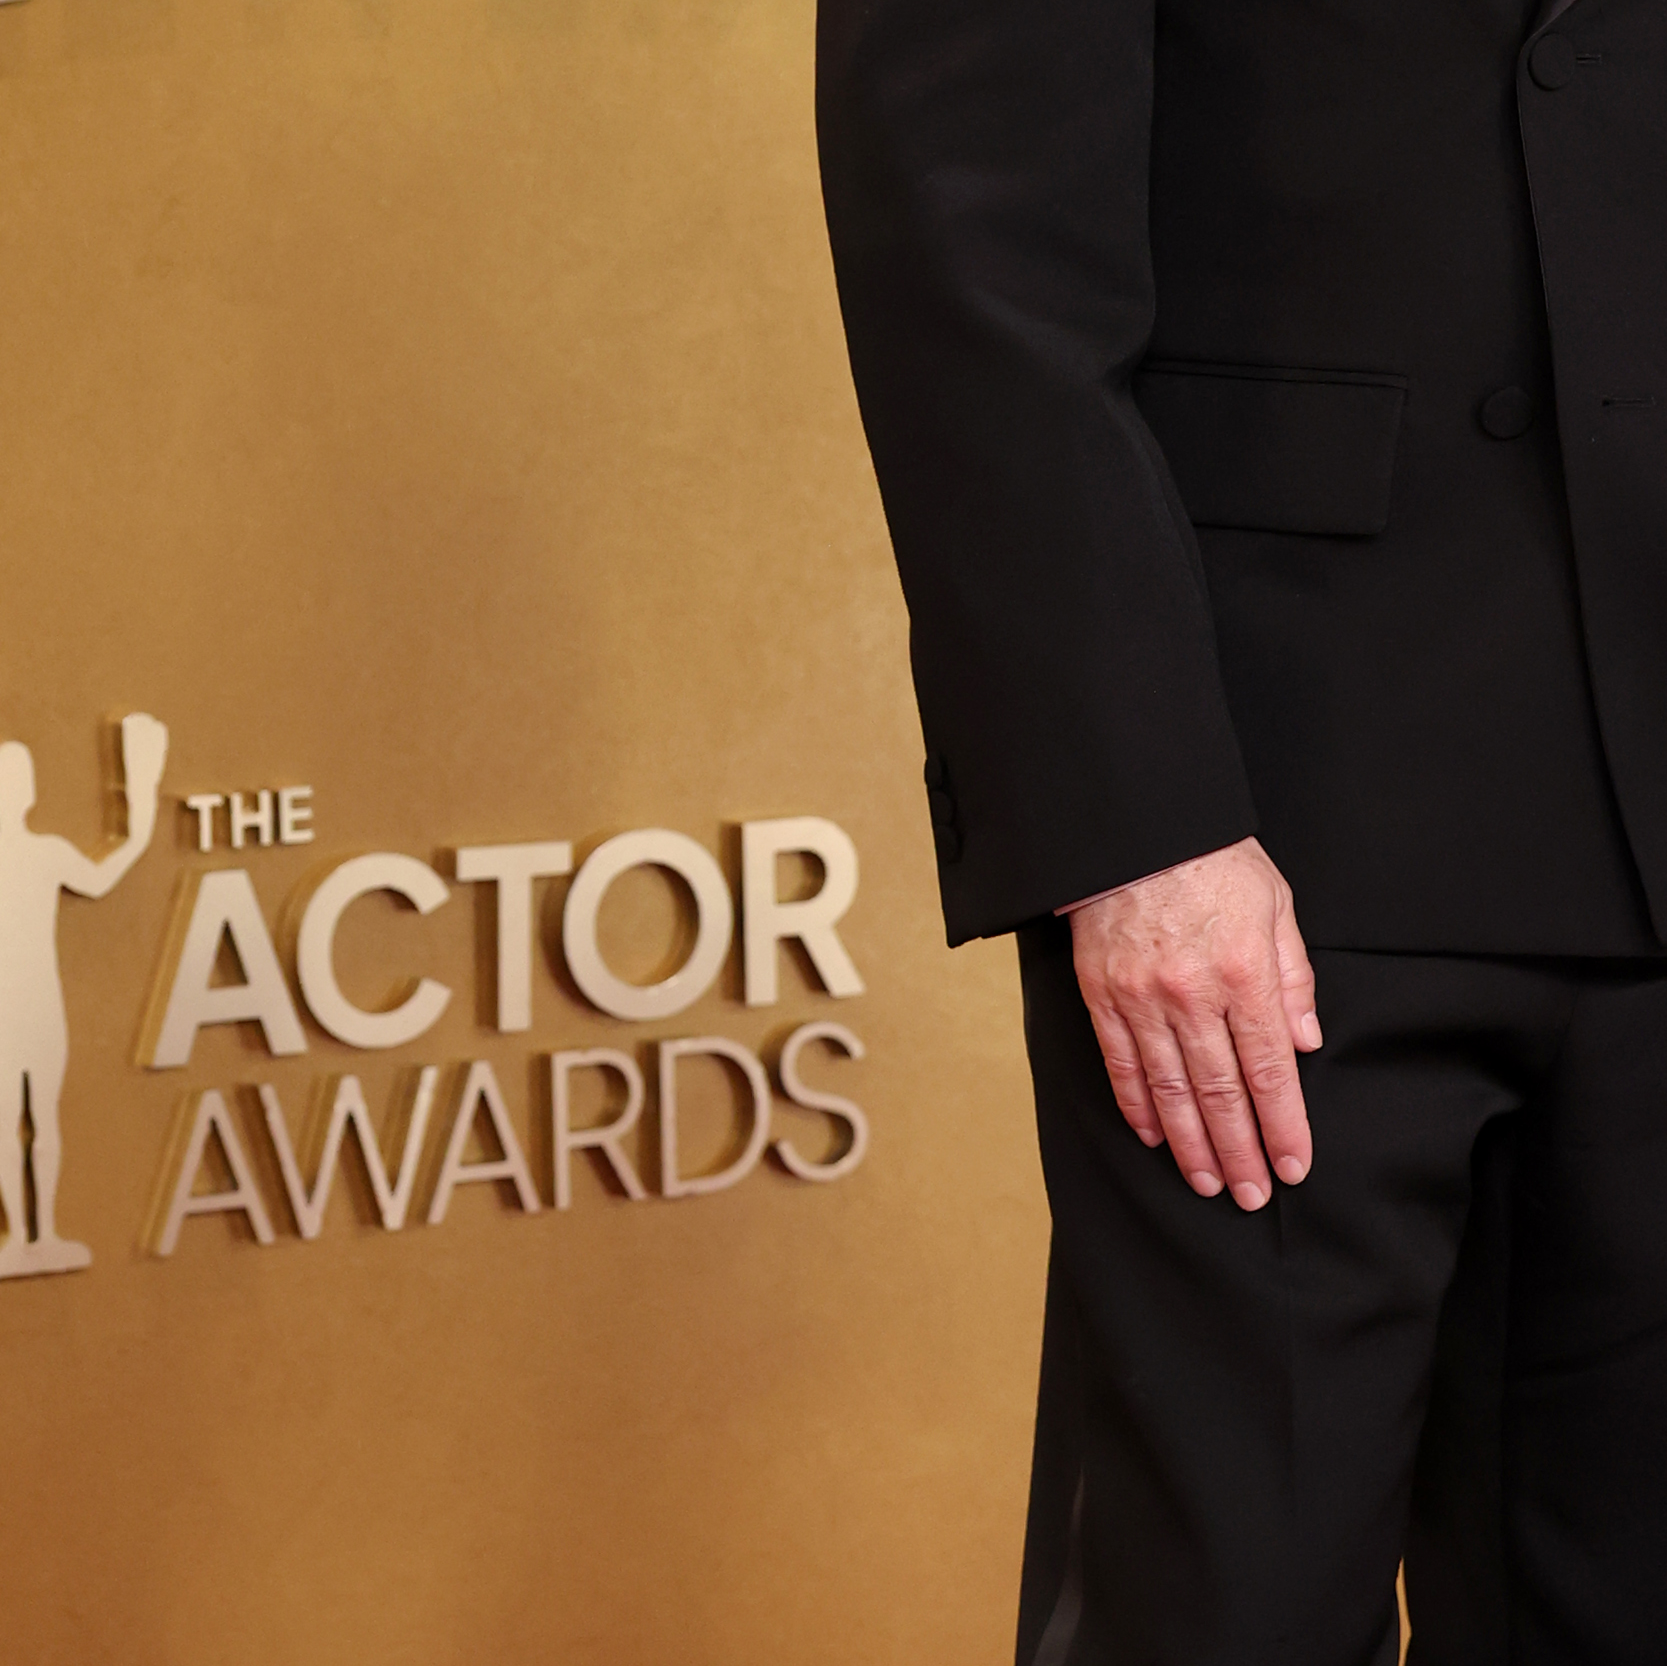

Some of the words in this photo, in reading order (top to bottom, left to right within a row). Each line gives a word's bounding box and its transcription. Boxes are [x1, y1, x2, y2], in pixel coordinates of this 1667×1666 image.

[186, 785, 315, 853] THE
[143, 816, 866, 1070] ACTOR
[154, 1022, 870, 1257] AWARDS
